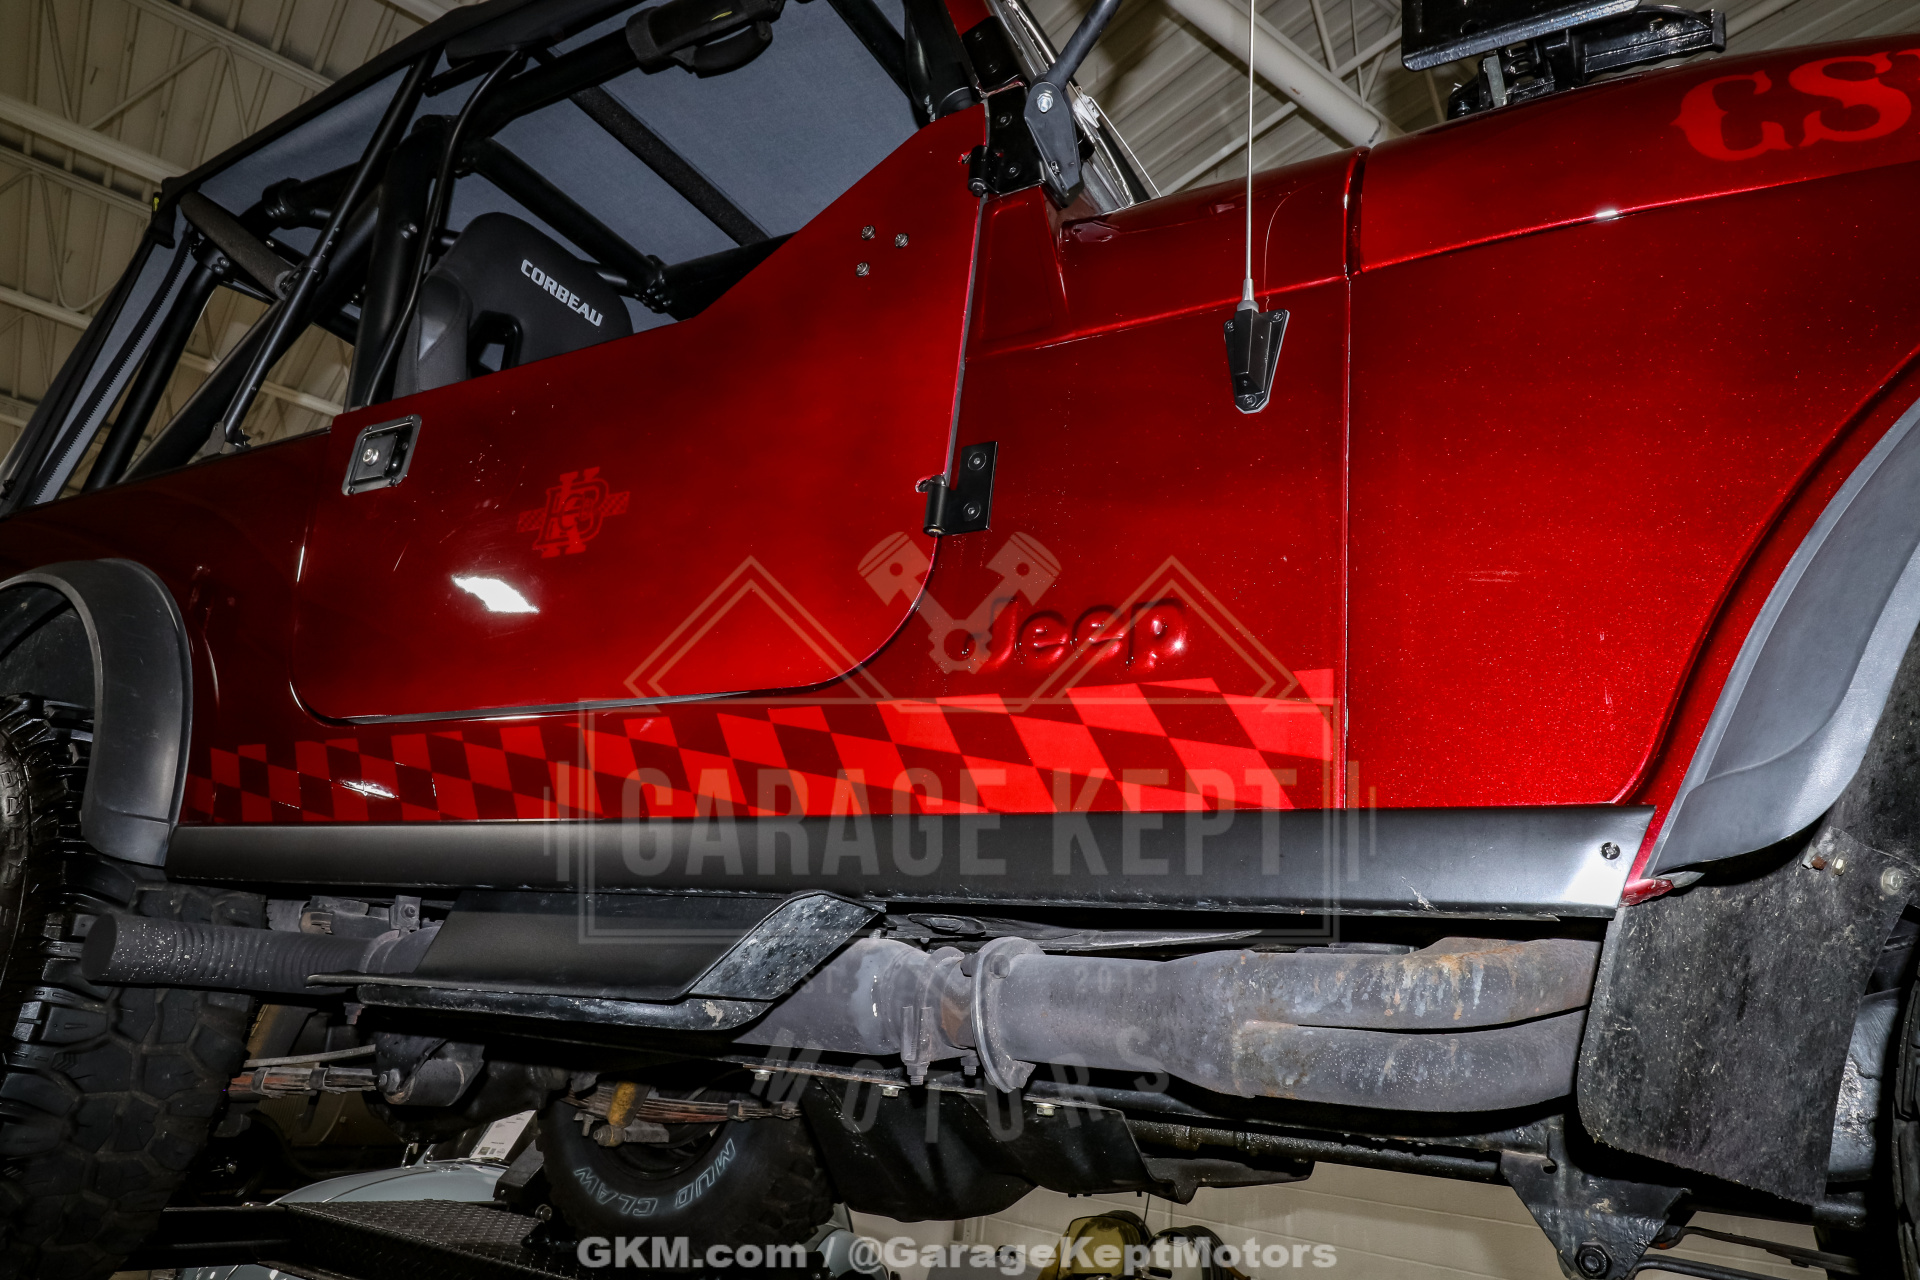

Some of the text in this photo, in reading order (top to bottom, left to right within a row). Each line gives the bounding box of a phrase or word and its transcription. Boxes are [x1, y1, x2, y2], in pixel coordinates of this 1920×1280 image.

[1669, 48, 1920, 162] CS
[521, 259, 603, 327] CORBEAU
[963, 597, 1188, 674] Jeep
[574, 1138, 736, 1217] MUD CLAW
